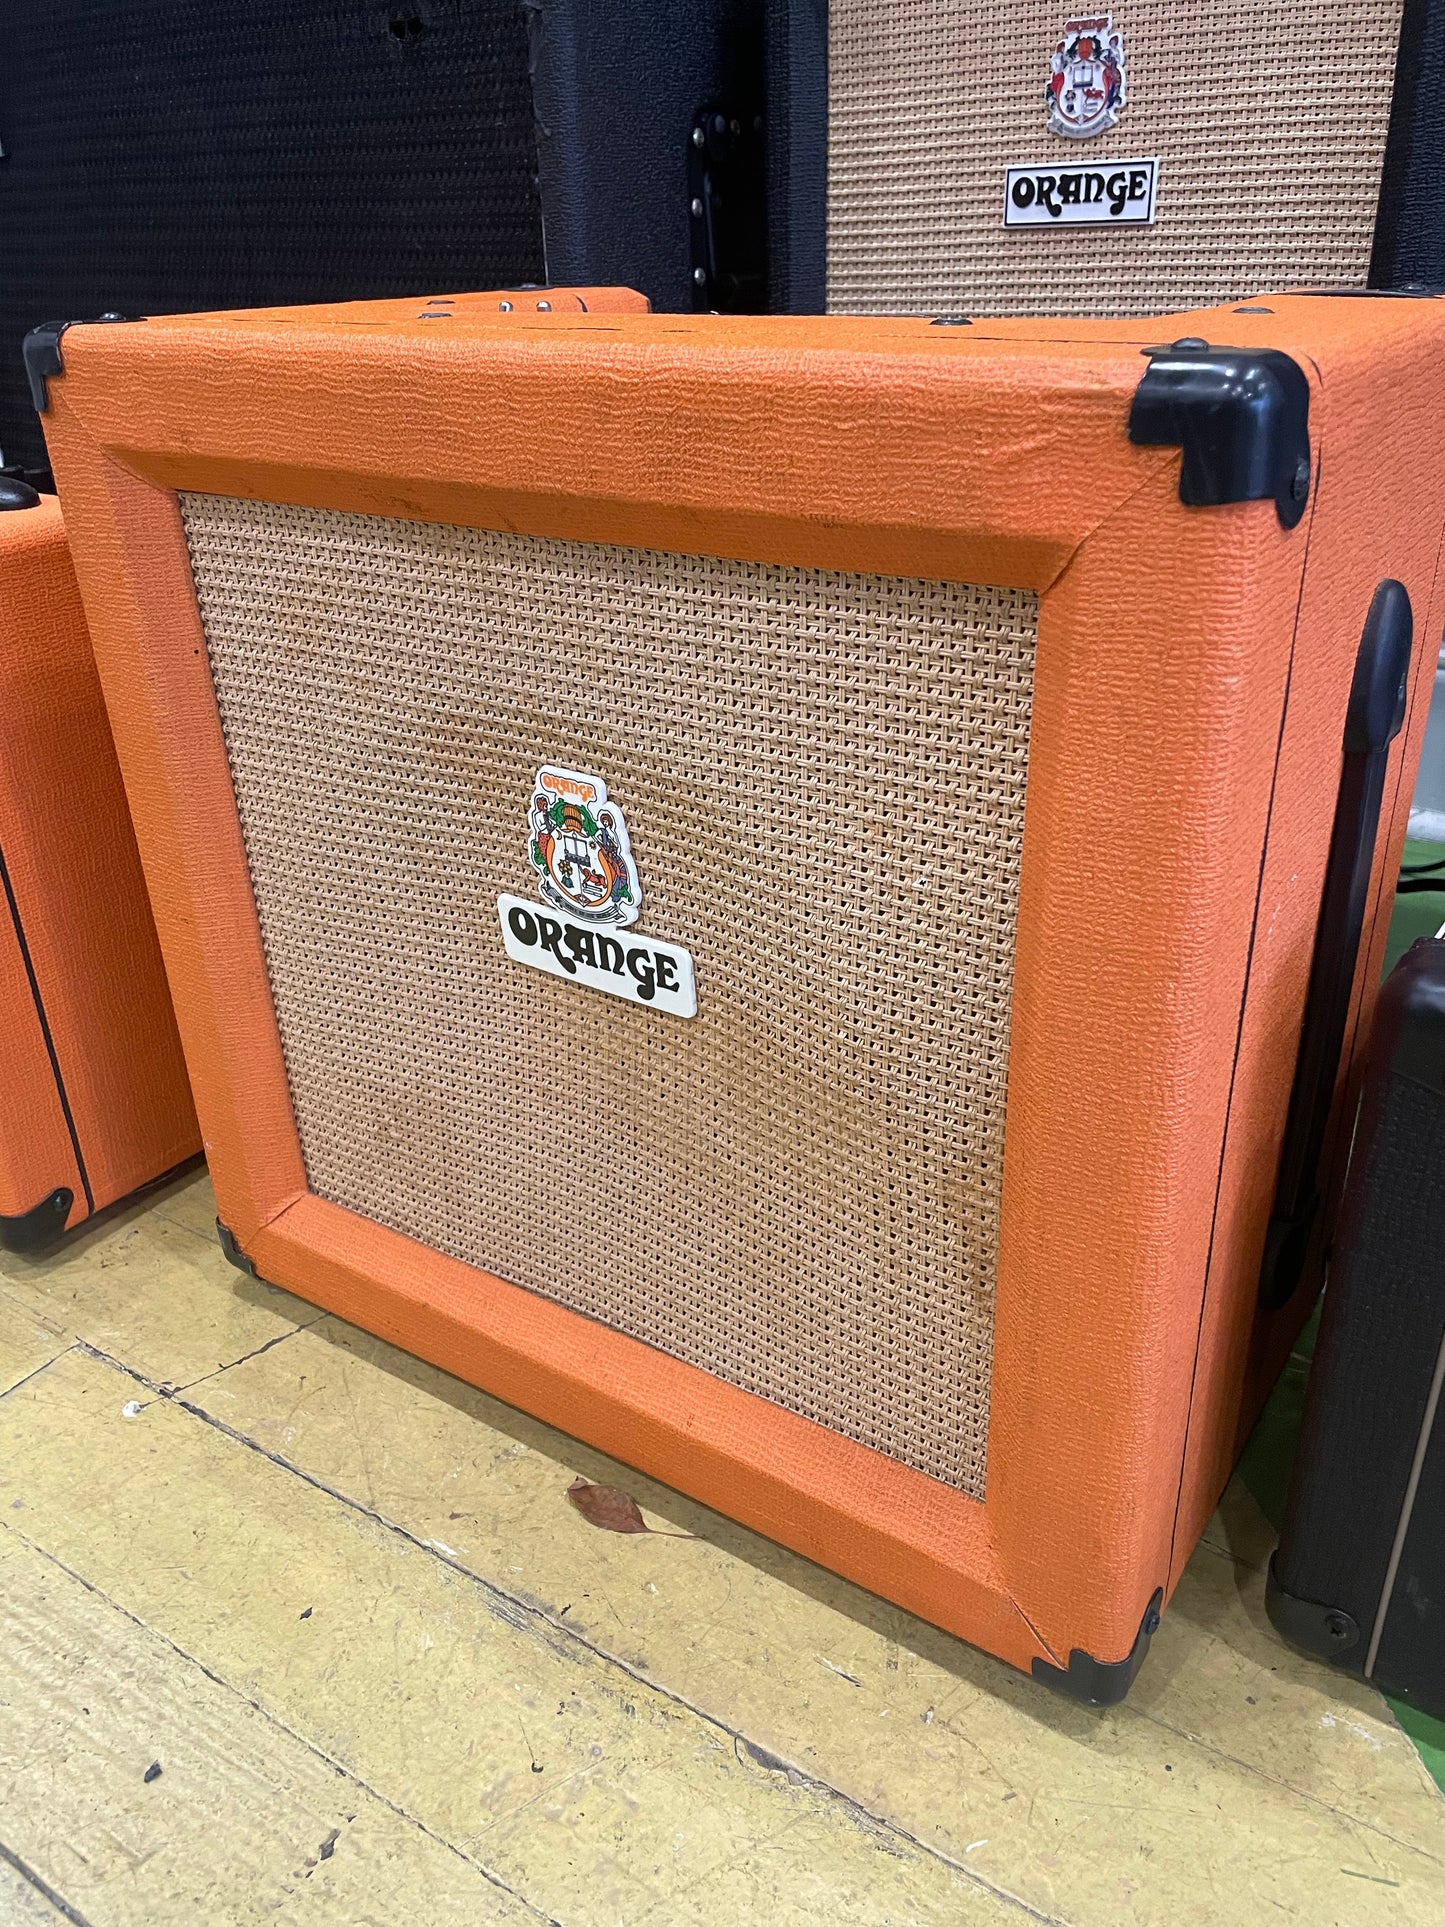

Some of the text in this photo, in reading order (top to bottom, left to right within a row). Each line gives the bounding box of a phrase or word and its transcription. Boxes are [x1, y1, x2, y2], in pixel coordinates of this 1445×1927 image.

[1012, 170, 1147, 217] ORANGE
[543, 774, 595, 802] ORANGE
[508, 907, 680, 1000] ORANGE
